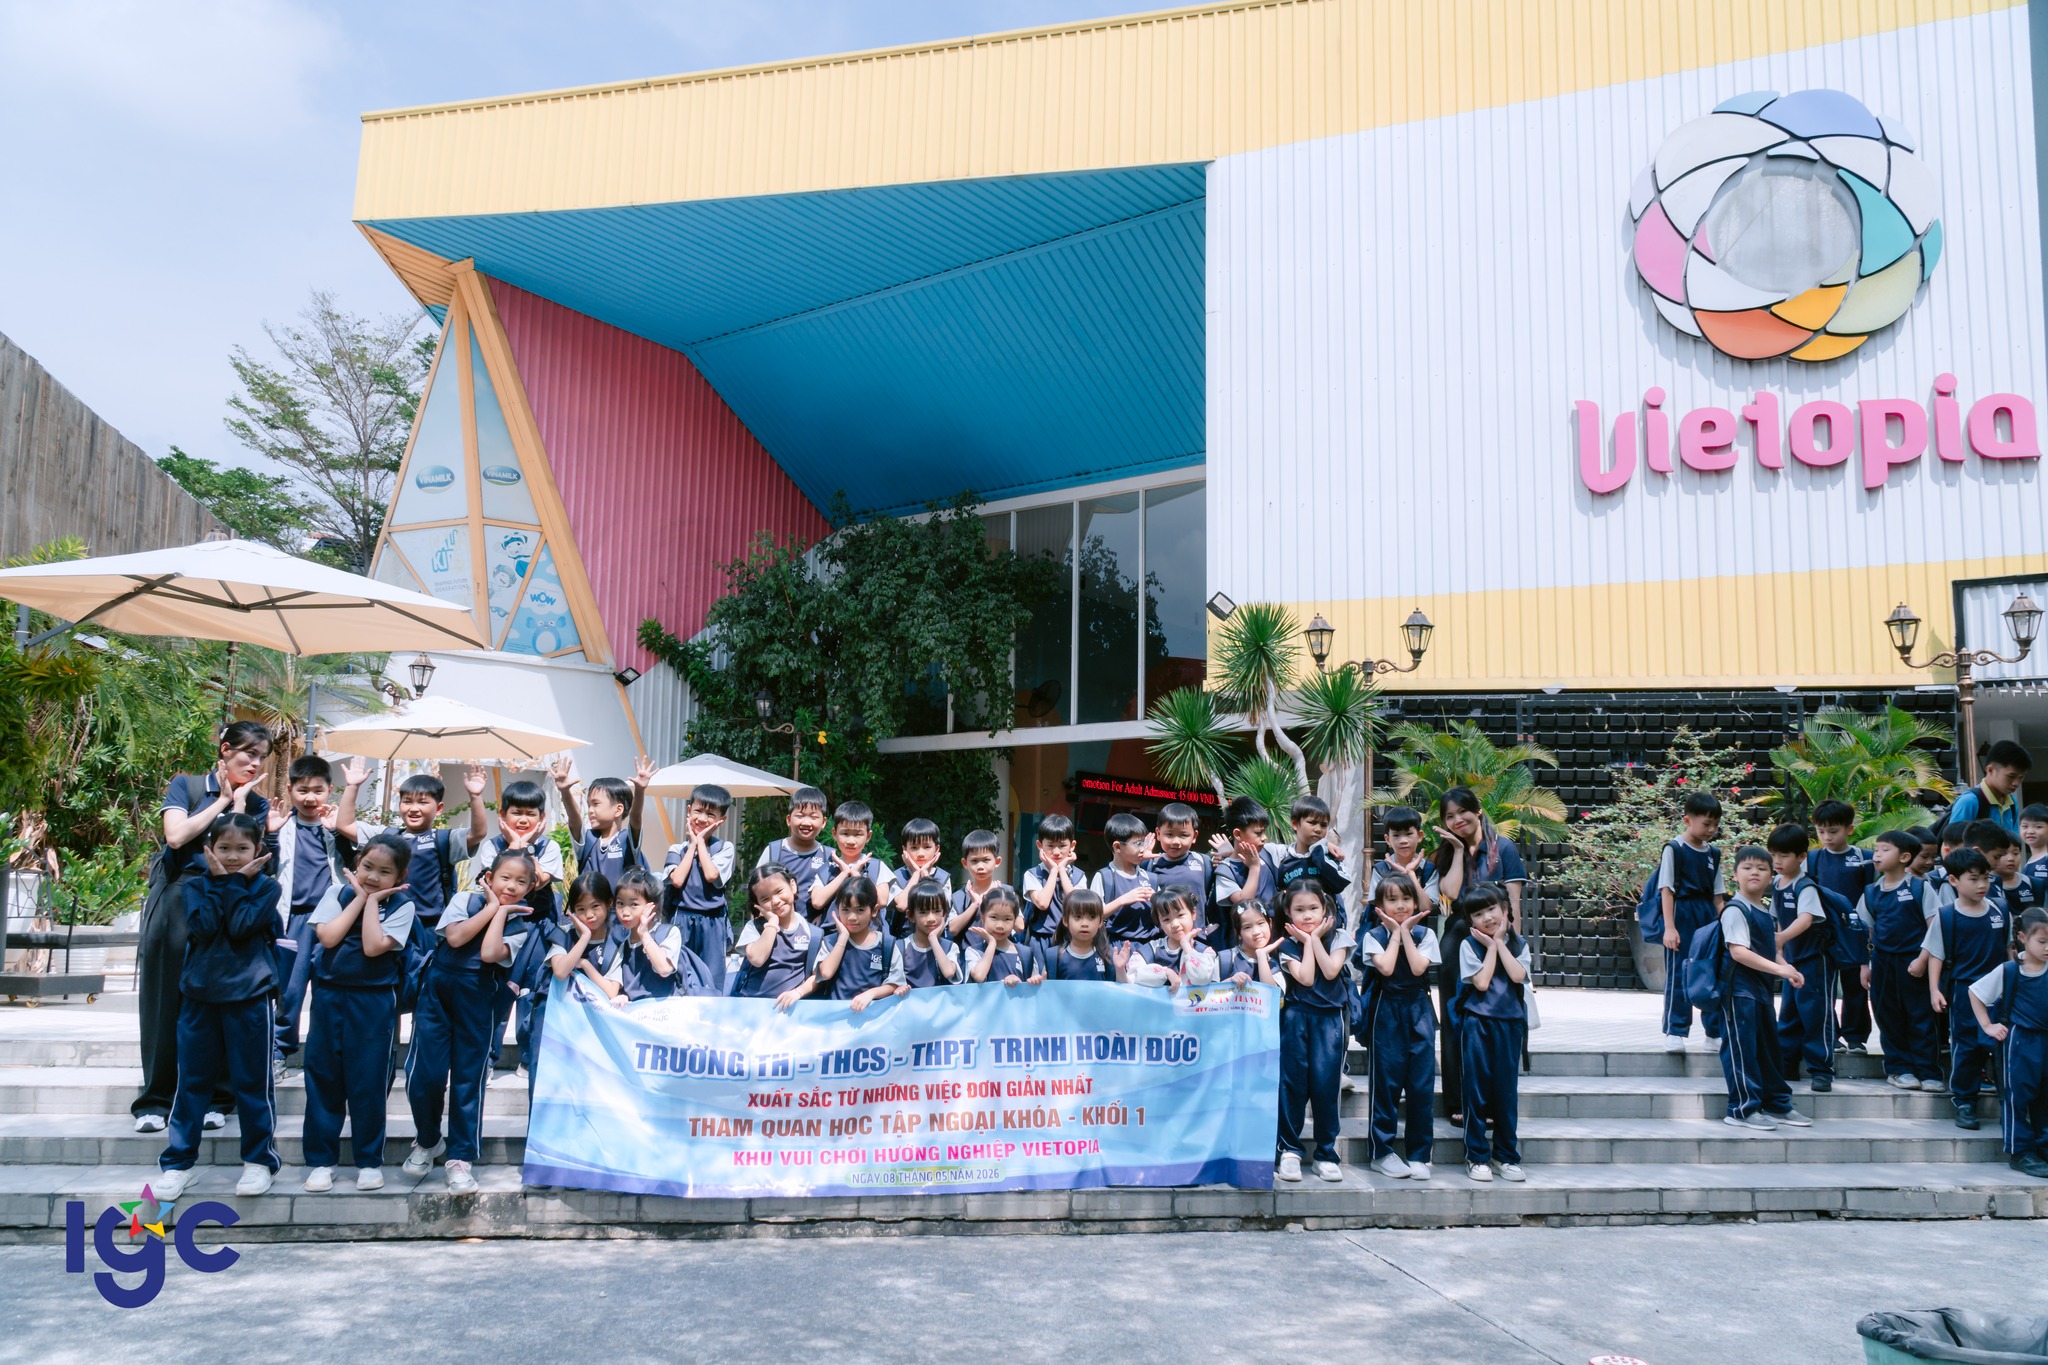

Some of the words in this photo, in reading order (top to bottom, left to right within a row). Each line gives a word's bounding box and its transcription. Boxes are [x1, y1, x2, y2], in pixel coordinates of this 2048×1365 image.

[420, 473, 453, 484] VINAMILK
[486, 471, 518, 480] VINAMILK
[530, 592, 556, 605] WOW
[1111, 780, 1123, 793] For
[1124, 782, 1143, 795] Adult
[635, 1042, 745, 1077] TRƯỜNG
[755, 1052, 789, 1077] TH
[818, 1046, 886, 1075] THCS
[912, 1039, 975, 1067] THPT
[990, 1036, 1067, 1068] TRỊNH
[1076, 1032, 1136, 1061] HOÀI
[1144, 1033, 1197, 1062] ĐỨC
[748, 1087, 793, 1107] XUẤT
[798, 1085, 832, 1108] SẮC
[838, 1087, 860, 1106] TỪ
[863, 1083, 920, 1105] NHỮNG
[925, 1080, 962, 1104] VIỆC
[967, 1080, 1000, 1098] ĐƠN
[1006, 1075, 1046, 1097] GIẢN
[1051, 1072, 1093, 1096] NHẤT
[689, 1117, 753, 1137] THAM
[761, 1118, 822, 1139] QUAN
[829, 1115, 873, 1140] HỌC
[880, 1110, 921, 1138] TẬP
[929, 1110, 996, 1135] NGOẠI
[1003, 1104, 1062, 1129] KHÓA
[1082, 1100, 1128, 1126] KHỐI
[1136, 1107, 1145, 1126] 1
[733, 1150, 773, 1166] KHU
[780, 1150, 812, 1165] VUI
[819, 1147, 867, 1164] CHƠI
[873, 1143, 940, 1163] HƯỚNG
[949, 1139, 1016, 1161] NGHIỆP
[1022, 1139, 1100, 1157] VIETOPIA
[852, 1170, 881, 1184] NGÀY
[883, 1173, 895, 1183] 08
[898, 1168, 933, 1184] THÁNG
[935, 1171, 947, 1182] 05
[950, 1167, 974, 1181] NĂM
[976, 1168, 1000, 1180] 2026
